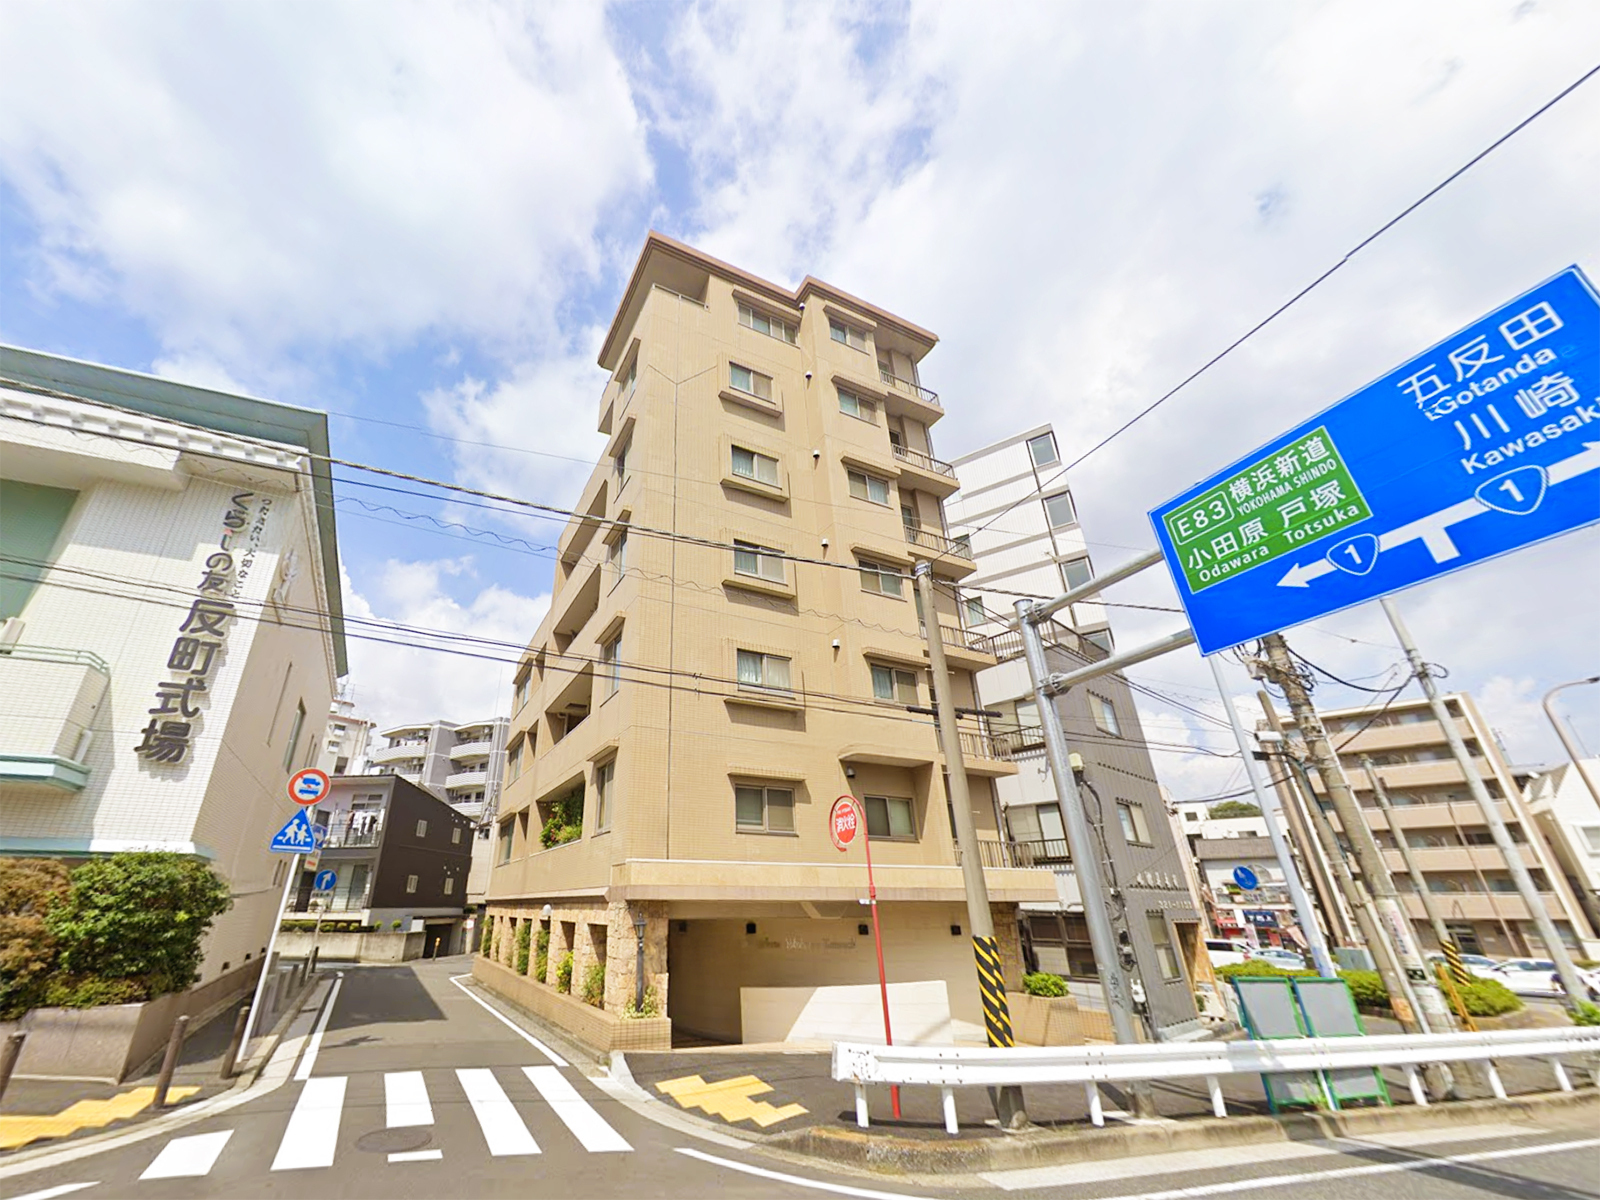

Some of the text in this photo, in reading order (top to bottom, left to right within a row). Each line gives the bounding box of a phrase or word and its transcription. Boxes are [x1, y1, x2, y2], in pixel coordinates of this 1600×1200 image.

[1397, 301, 1565, 405] 五反田
[1431, 348, 1557, 415] Gotanda
[1454, 371, 1580, 451] 川崎
[1228, 436, 1330, 503] 横浜新道
[1236, 458, 1338, 517] YOKOHAMA SHINDO
[1498, 478, 1525, 504] 1
[1177, 501, 1227, 538] E83
[1188, 479, 1347, 570] 小田原 戸塚
[1199, 504, 1360, 582] Odawara Totsuka
[1344, 543, 1362, 565] 1
[134, 598, 234, 763] 反町式場
[836, 813, 856, 833] 消火栓
